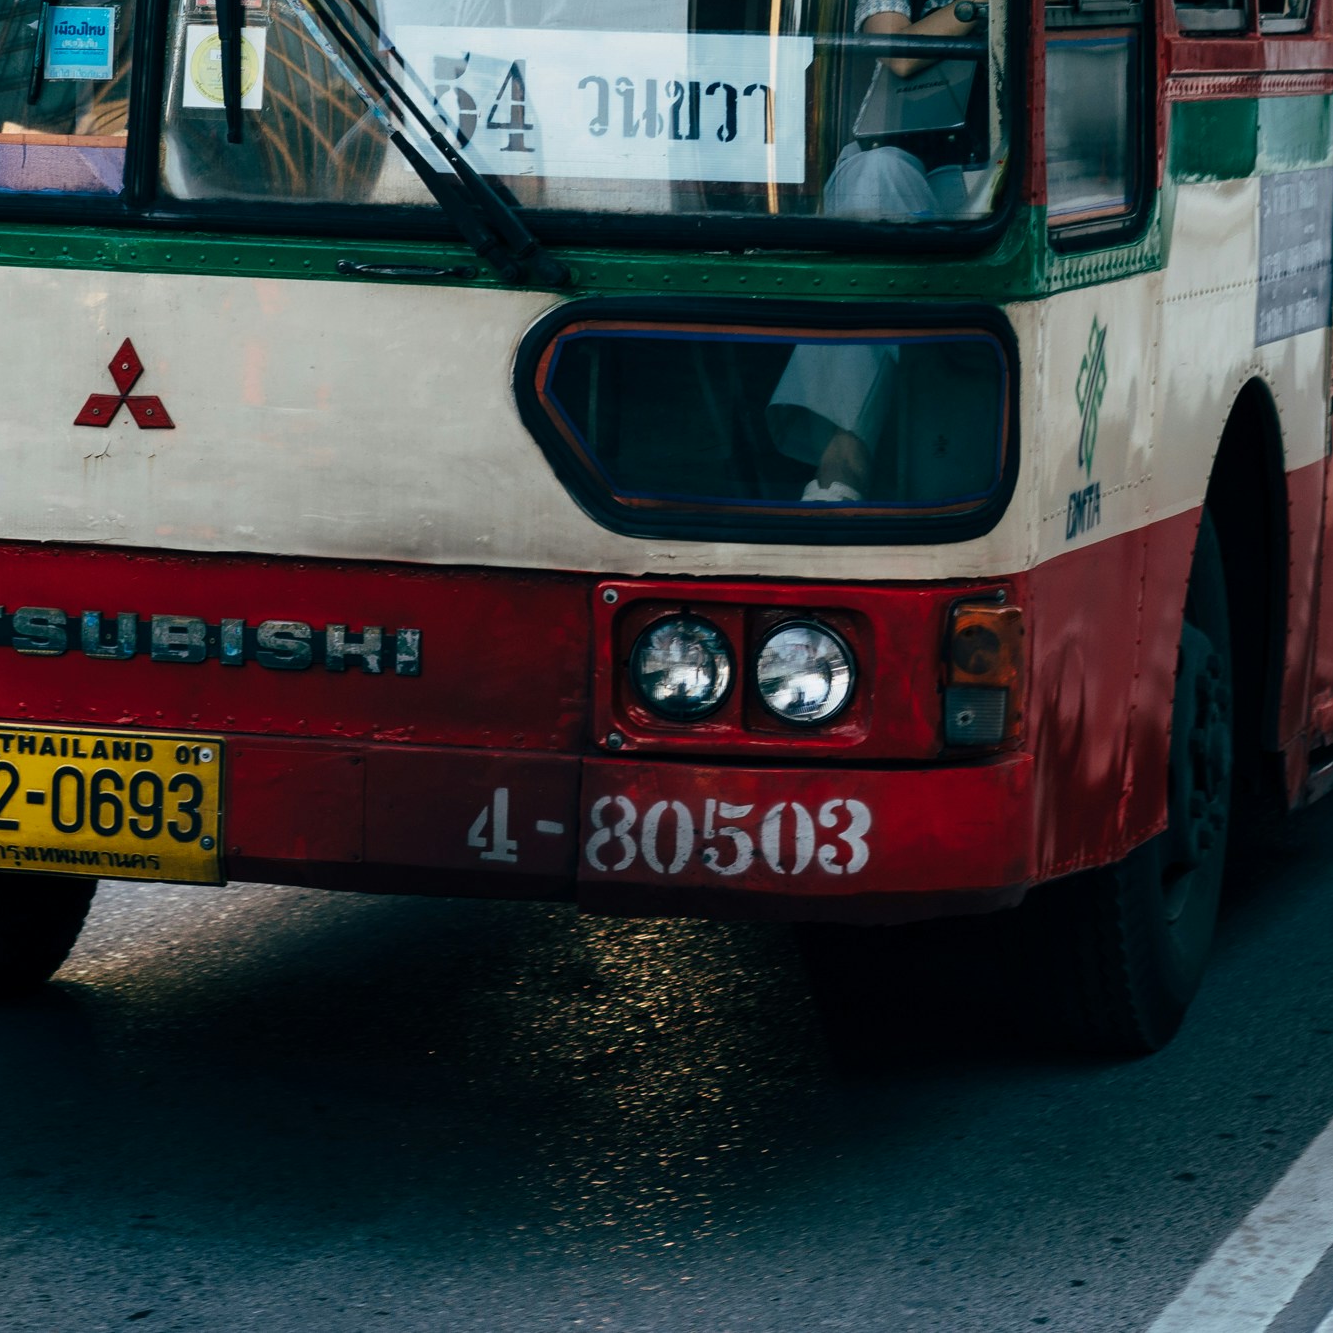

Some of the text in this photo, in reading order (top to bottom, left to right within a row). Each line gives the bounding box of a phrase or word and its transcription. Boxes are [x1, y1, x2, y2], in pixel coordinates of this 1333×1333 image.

[54, 20, 106, 36] เมืองไทย
[432, 51, 775, 153] 54 วนขวา
